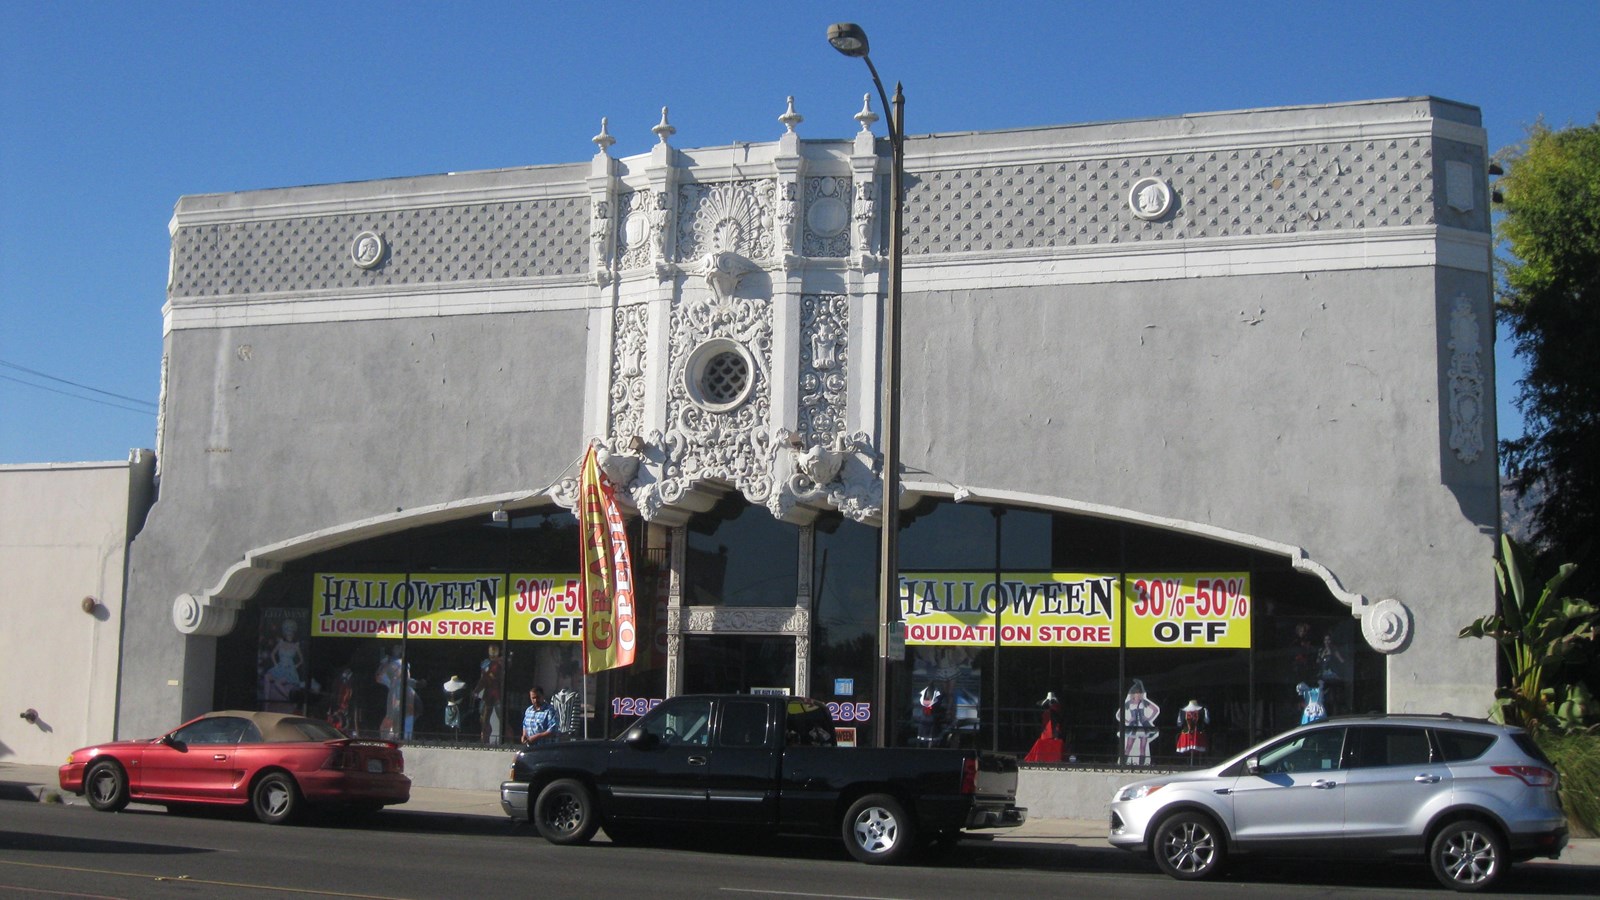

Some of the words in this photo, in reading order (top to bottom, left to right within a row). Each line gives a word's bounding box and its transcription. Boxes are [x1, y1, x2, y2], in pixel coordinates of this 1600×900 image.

[586, 484, 613, 650] GRAND
[320, 576, 501, 616] HALLOWEEN
[898, 577, 1116, 620] HALLOWEEN
[1133, 579, 1247, 618] 30%-50%
[321, 619, 432, 635] LIQUIDATION
[437, 620, 495, 636] STORE
[903, 625, 1031, 641] IQUIDATION
[1038, 626, 1111, 642] STORE
[1154, 622, 1227, 643] OFF
[826, 702, 871, 722] 285
